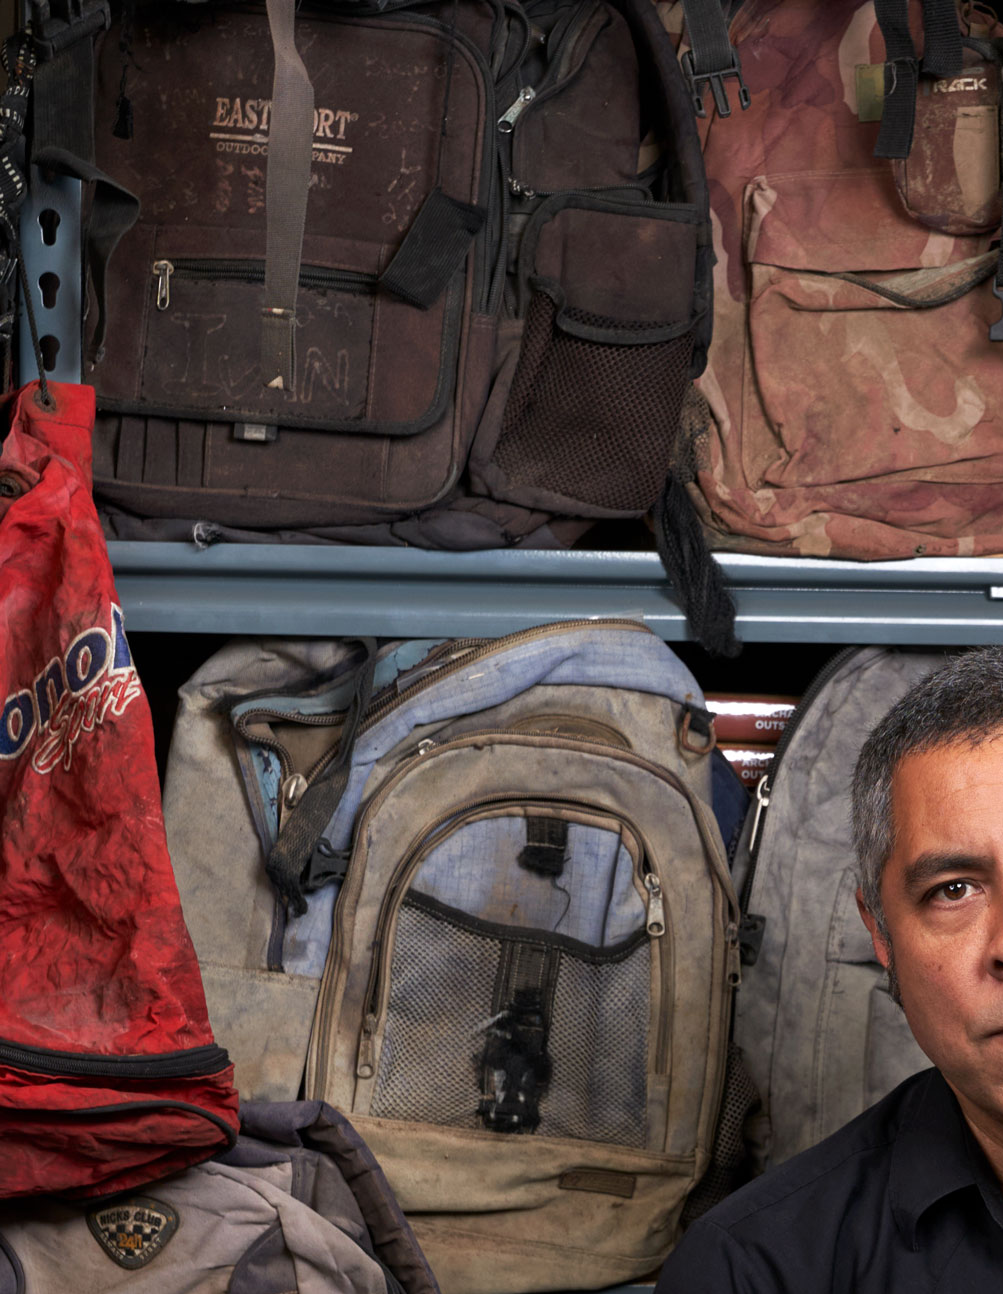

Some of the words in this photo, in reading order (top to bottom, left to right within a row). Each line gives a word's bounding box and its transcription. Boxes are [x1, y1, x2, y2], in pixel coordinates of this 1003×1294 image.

[212, 97, 351, 140] EASTRT
[216, 141, 269, 156] OUTDOO
[312, 151, 347, 165] PANY
